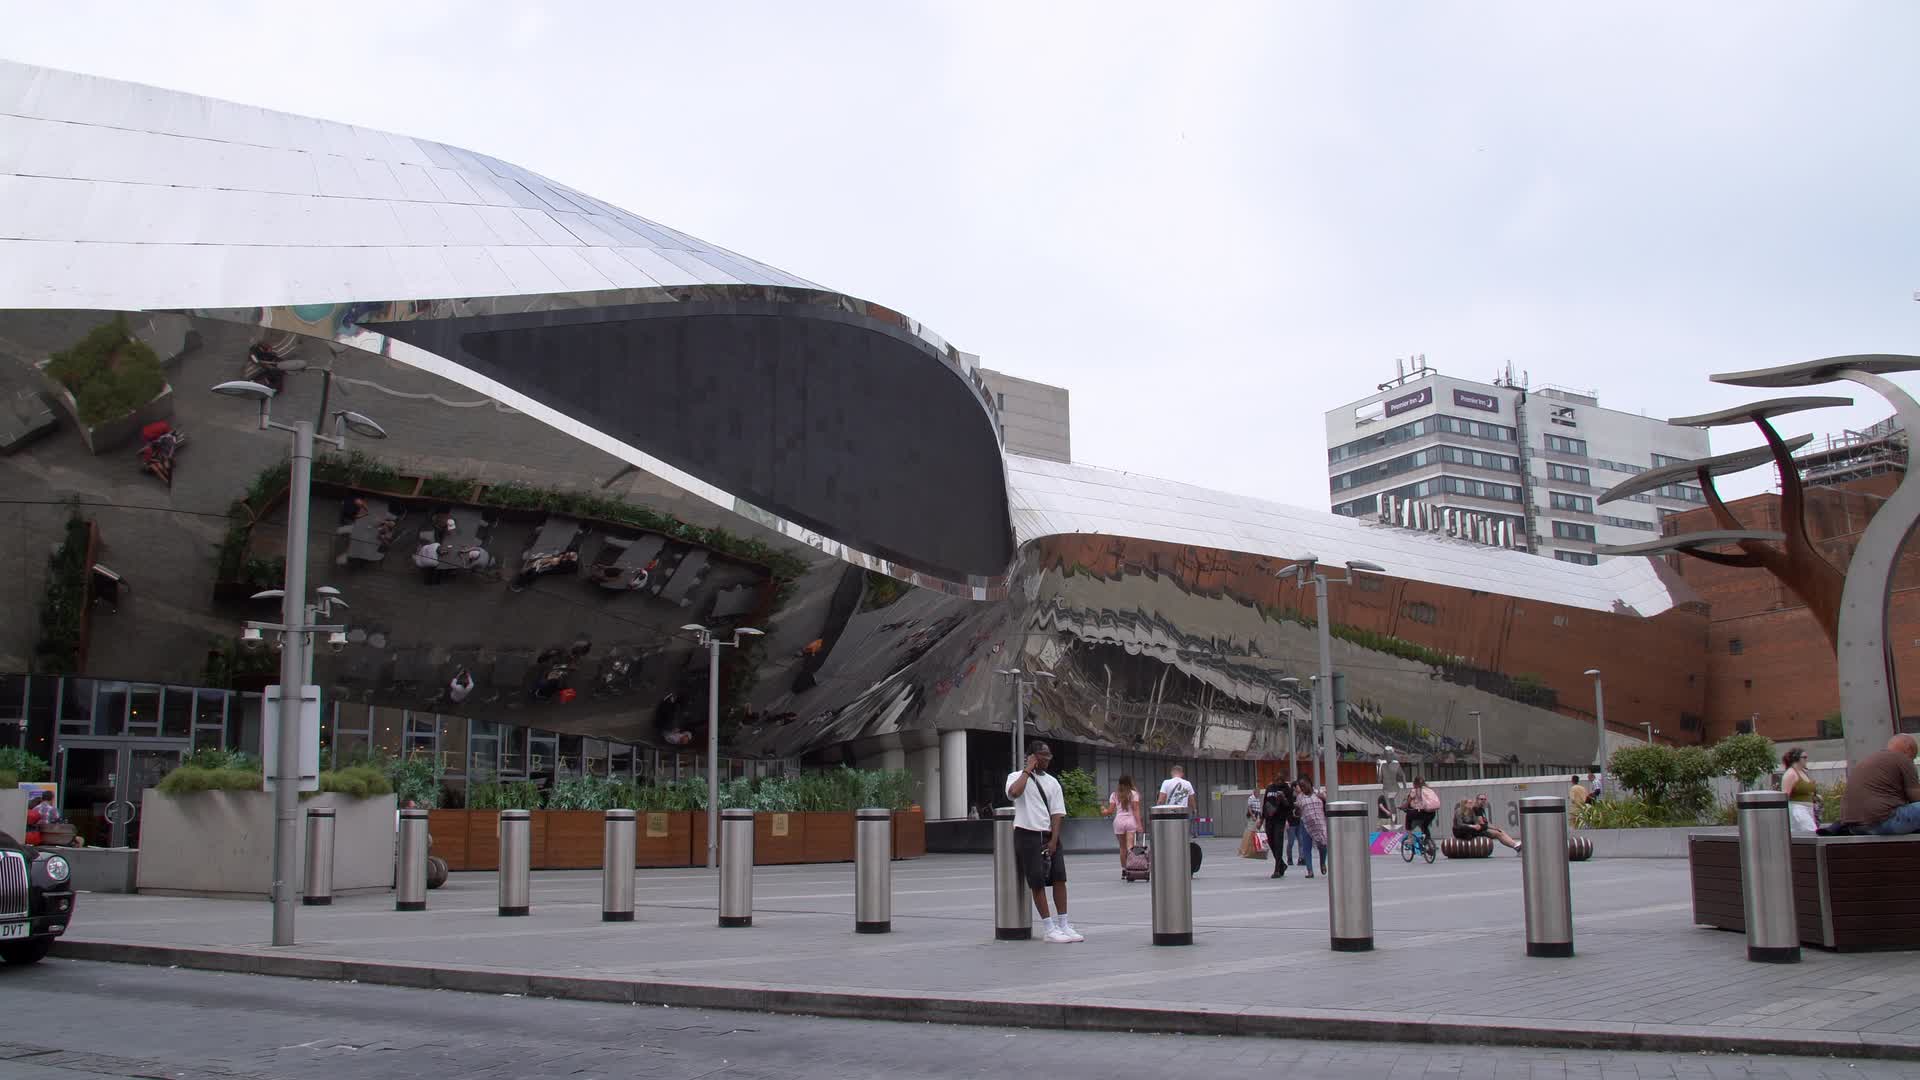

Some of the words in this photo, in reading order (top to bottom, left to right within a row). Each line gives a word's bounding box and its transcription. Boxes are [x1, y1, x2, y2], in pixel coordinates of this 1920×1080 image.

[1390, 399, 1409, 412] Premier
[1460, 394, 1478, 405] Premier
[1376, 492, 1440, 531] GRAND
[1444, 508, 1517, 549] CENTRAL
[532, 754, 595, 773] BAR
[2, 924, 23, 936] DVT
